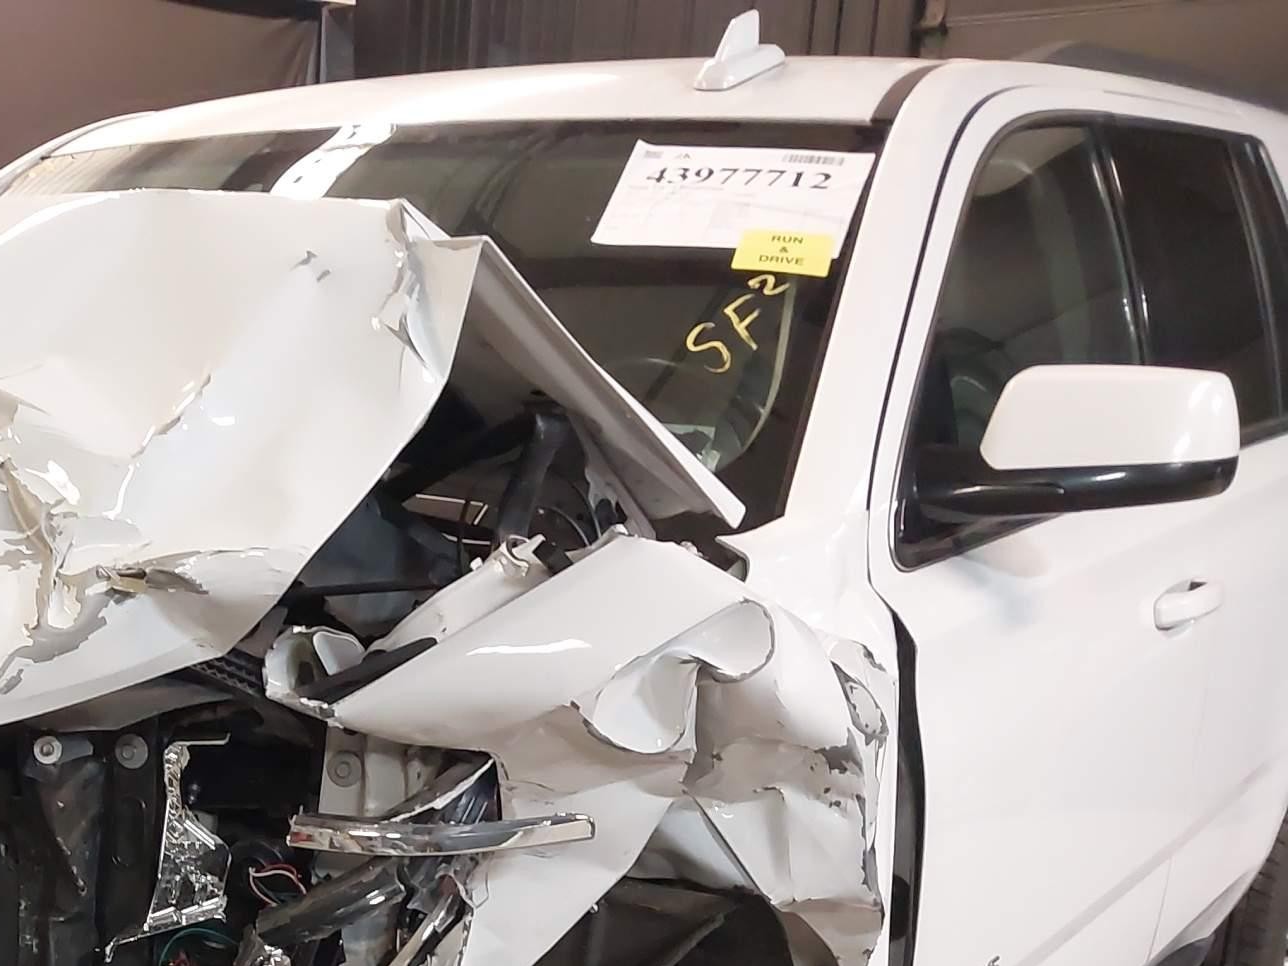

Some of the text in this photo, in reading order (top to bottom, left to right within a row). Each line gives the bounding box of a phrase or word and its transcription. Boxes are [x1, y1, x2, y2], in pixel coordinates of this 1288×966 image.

[646, 167, 833, 190] 43977712
[770, 234, 804, 244] RUN
[779, 246, 789, 254] &
[758, 254, 805, 266] DRIVE
